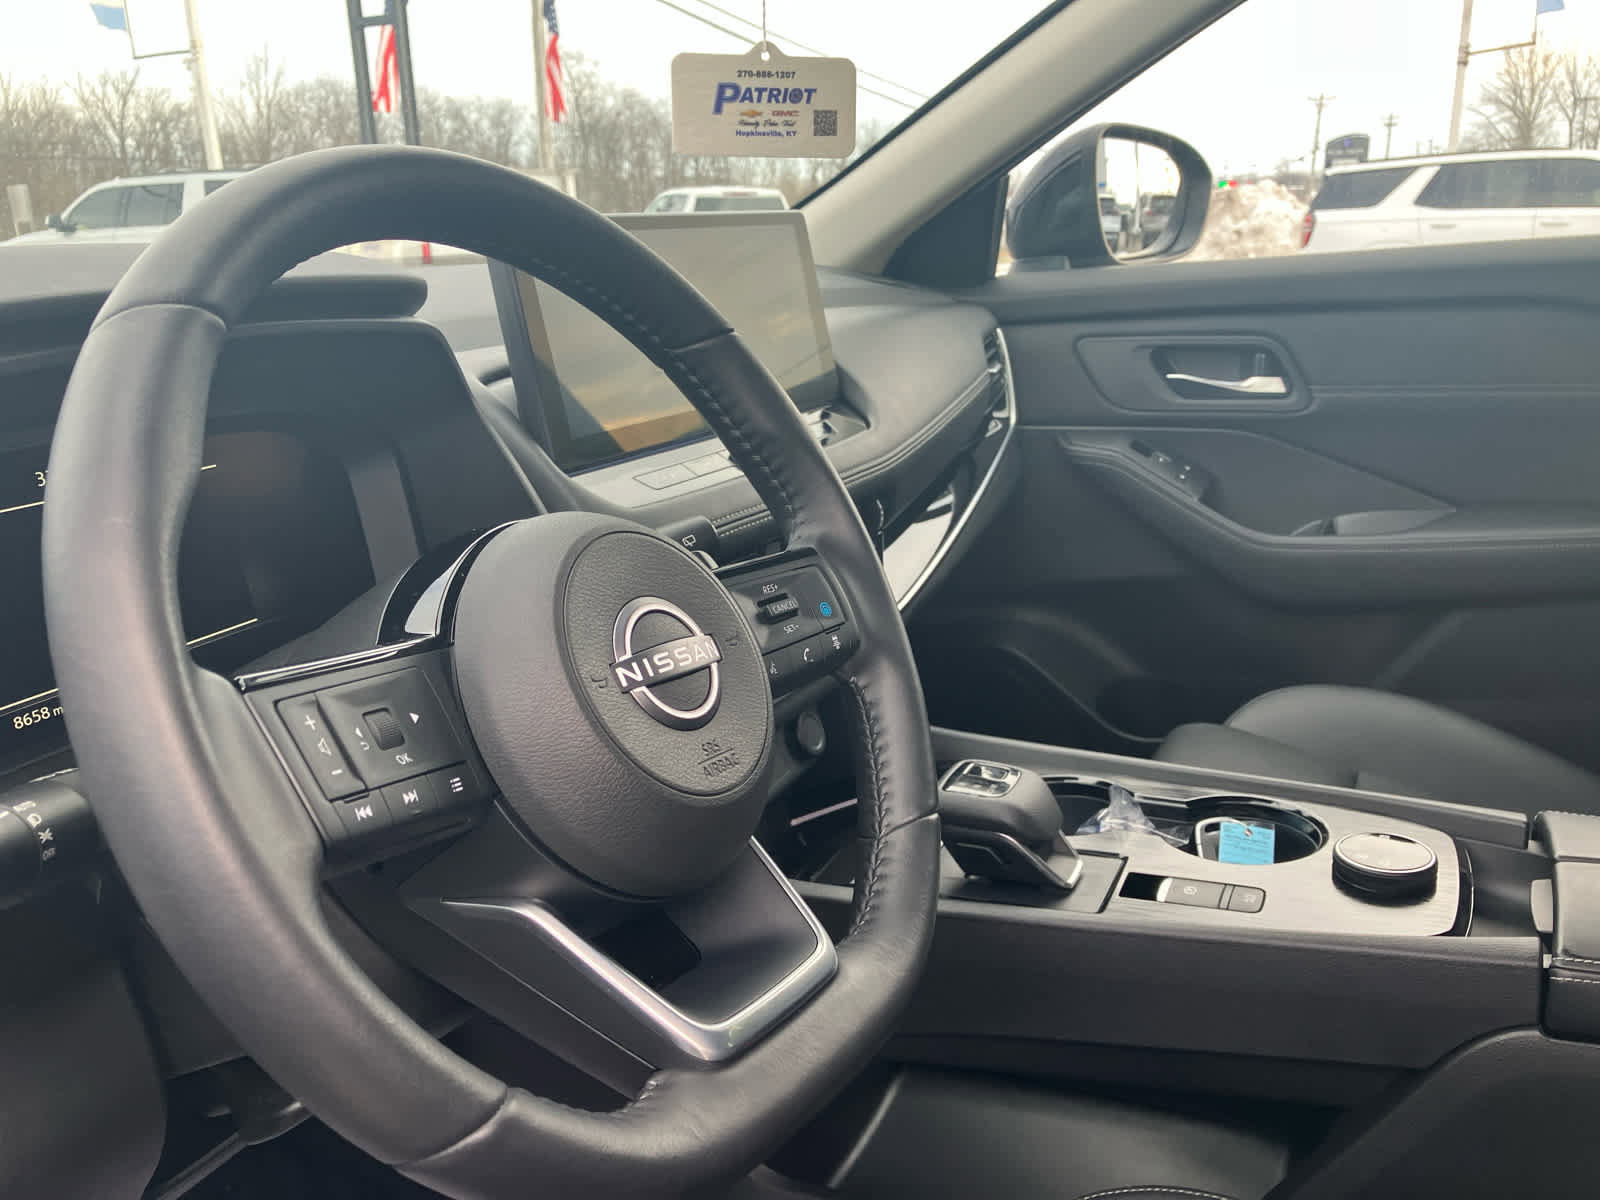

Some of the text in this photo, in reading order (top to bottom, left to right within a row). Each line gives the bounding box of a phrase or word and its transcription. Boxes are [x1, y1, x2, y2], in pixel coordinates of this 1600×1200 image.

[712, 82, 818, 115] PATRIOT
[615, 639, 720, 687] NISSAN
[13, 706, 51, 729] 8658
[395, 752, 414, 766] OK
